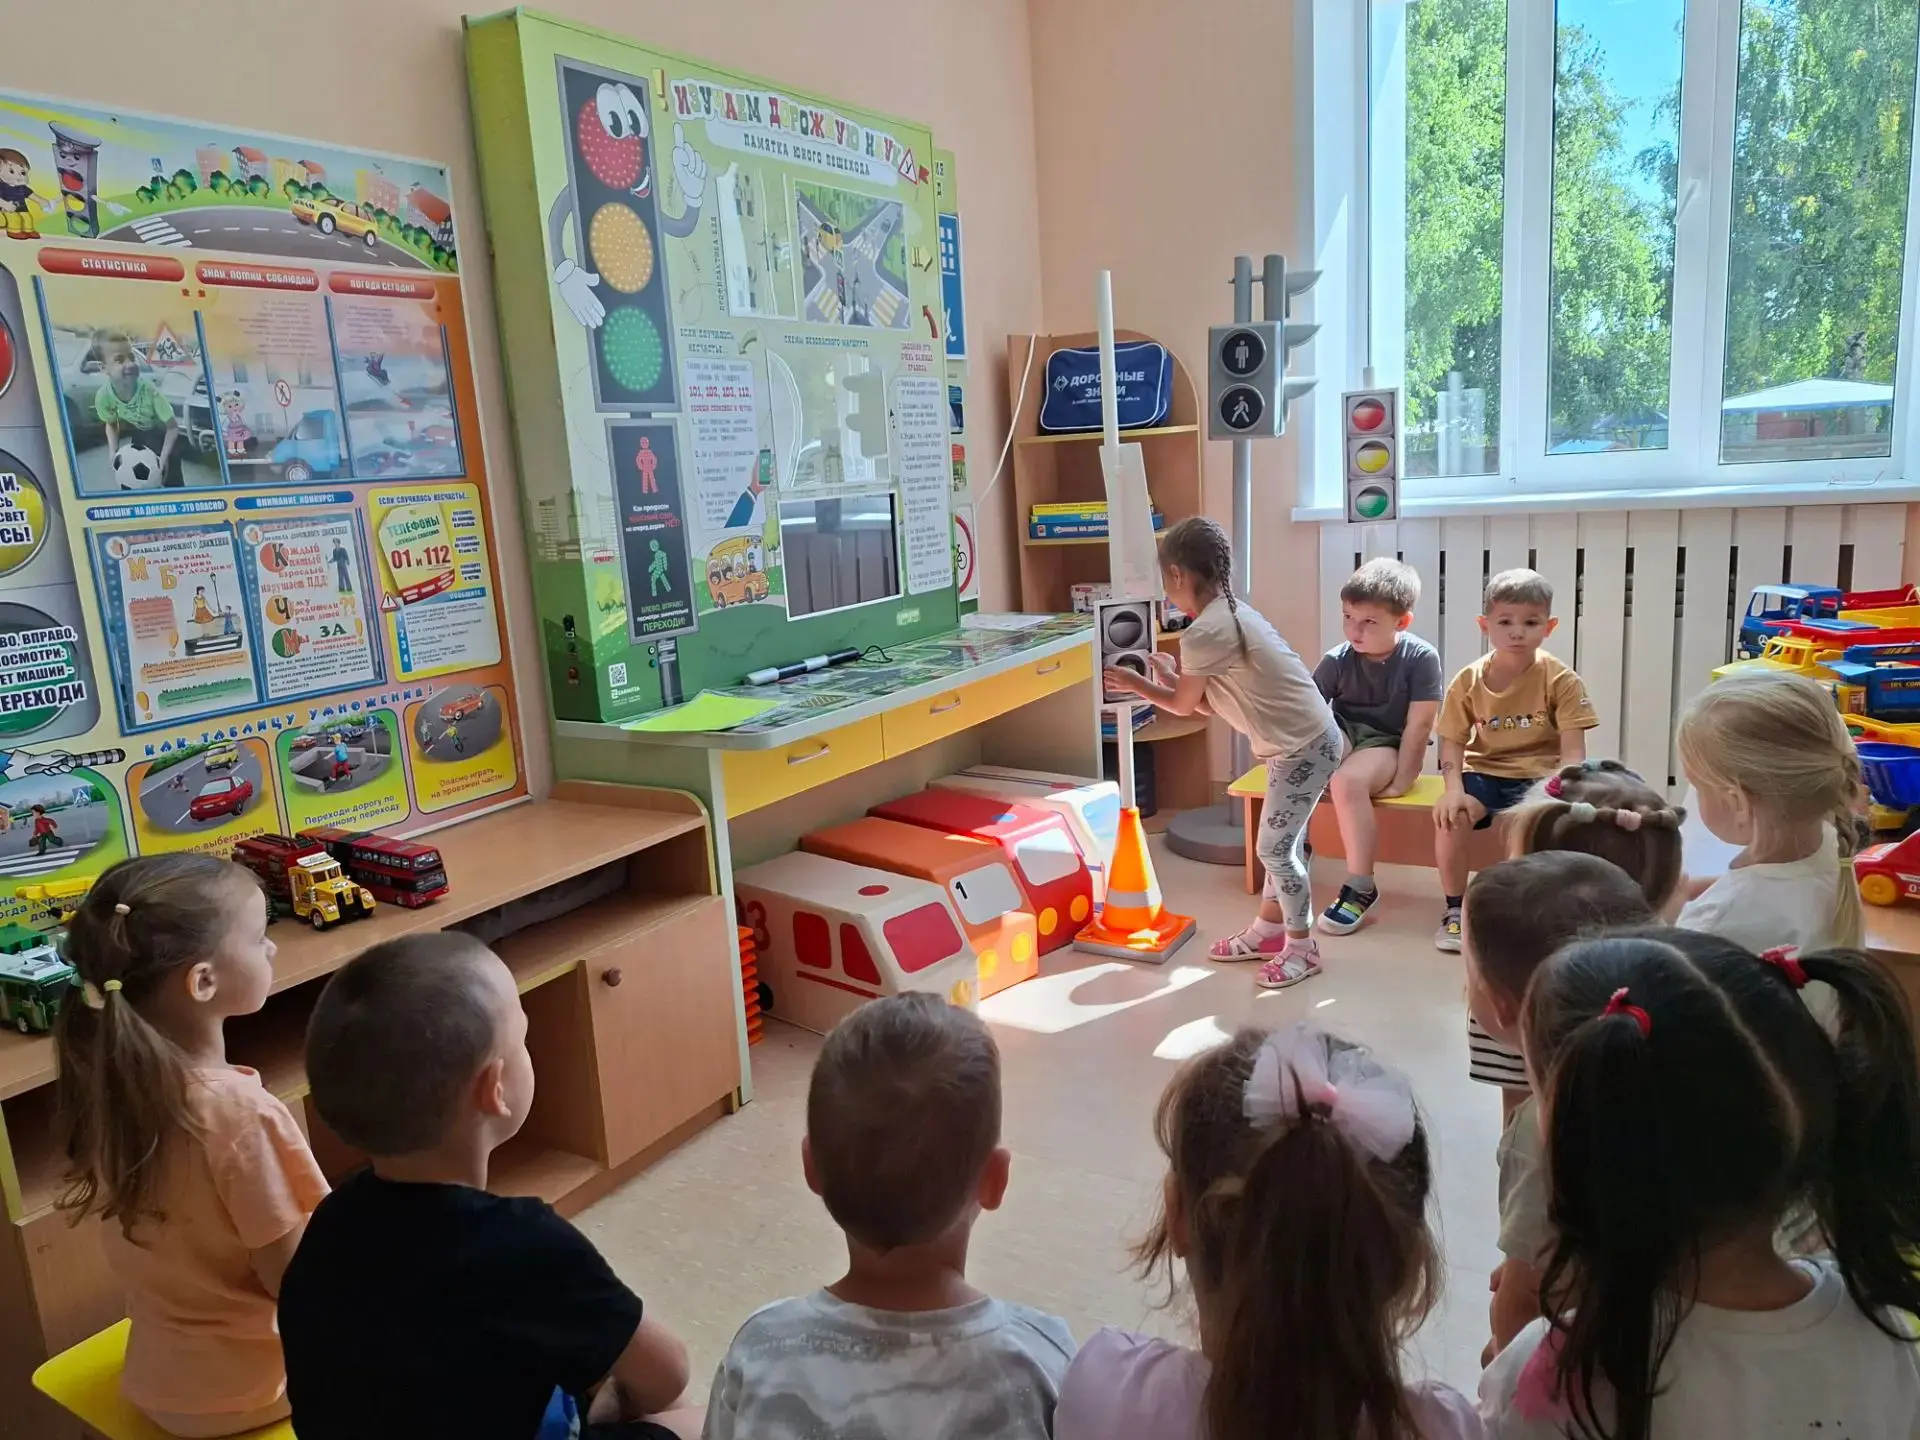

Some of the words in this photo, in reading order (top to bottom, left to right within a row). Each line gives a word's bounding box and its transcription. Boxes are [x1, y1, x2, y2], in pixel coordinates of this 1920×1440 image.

[674, 84, 762, 123] ИЗУЧАЕМ
[768, 96, 860, 151] ДОРОЖНУЮ
[744, 133, 789, 156] ПАМЯТКА
[793, 146, 822, 165] ЮНОГО
[826, 152, 870, 176] ПЕШЕХОДА
[81, 257, 148, 273] СТАТИСТИКА
[350, 278, 381, 290] ПОГОДА
[1070, 371, 1145, 386] ДОРОНЫЕ
[1085, 385, 1126, 398] ЗНИ
[378, 496, 394, 505] ЕСЛИ
[134, 506, 145, 517] НА
[182, 503, 195, 513] ЭТО
[387, 515, 441, 537] ТЕЛЕФОНЫ
[391, 549, 412, 569] 01
[423, 545, 451, 566] 112
[22, 627, 76, 645] ВПРАВО,
[320, 623, 347, 638] ЗА
[401, 640, 407, 649] 3
[0, 647, 65, 668] ОСМОТРИ:
[403, 653, 409, 663] 4
[17, 665, 65, 683] МАШИН
[0, 682, 85, 713] ЕРЕХОДИ
[143, 736, 188, 756] КАК
[201, 712, 296, 744] ТАБЛИЦУ
[439, 774, 469, 787] Опасно
[469, 767, 495, 782] играть
[430, 791, 441, 799] на
[304, 806, 350, 826] Переходи
[351, 798, 383, 815] дорогу
[384, 795, 396, 805] по
[359, 802, 401, 820] переходу
[203, 831, 250, 849] выбегать
[252, 826, 265, 835] на
[955, 880, 968, 900] 1
